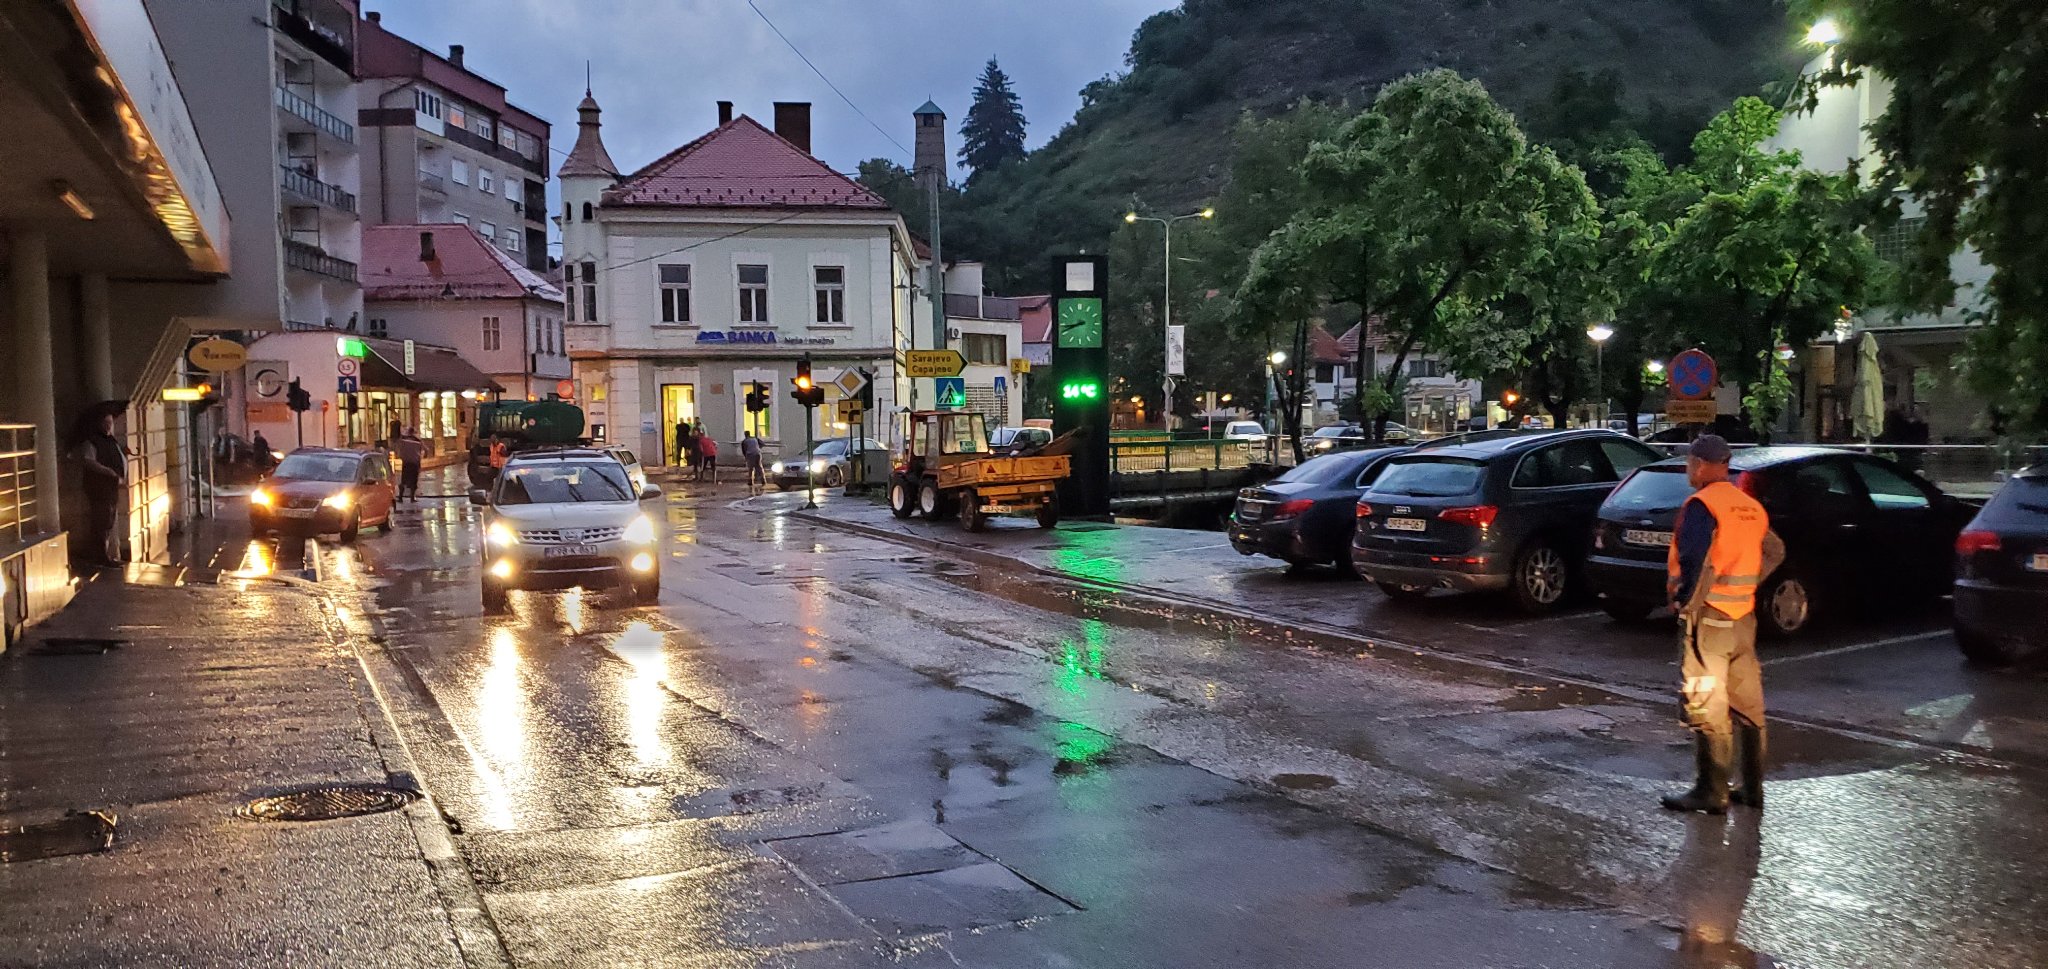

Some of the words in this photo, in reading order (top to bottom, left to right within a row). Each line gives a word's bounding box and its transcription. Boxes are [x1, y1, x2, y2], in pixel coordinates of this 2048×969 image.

[728, 331, 777, 344] BANKA
[912, 354, 952, 363] Sarajevo
[1063, 384, 1080, 398] 14
